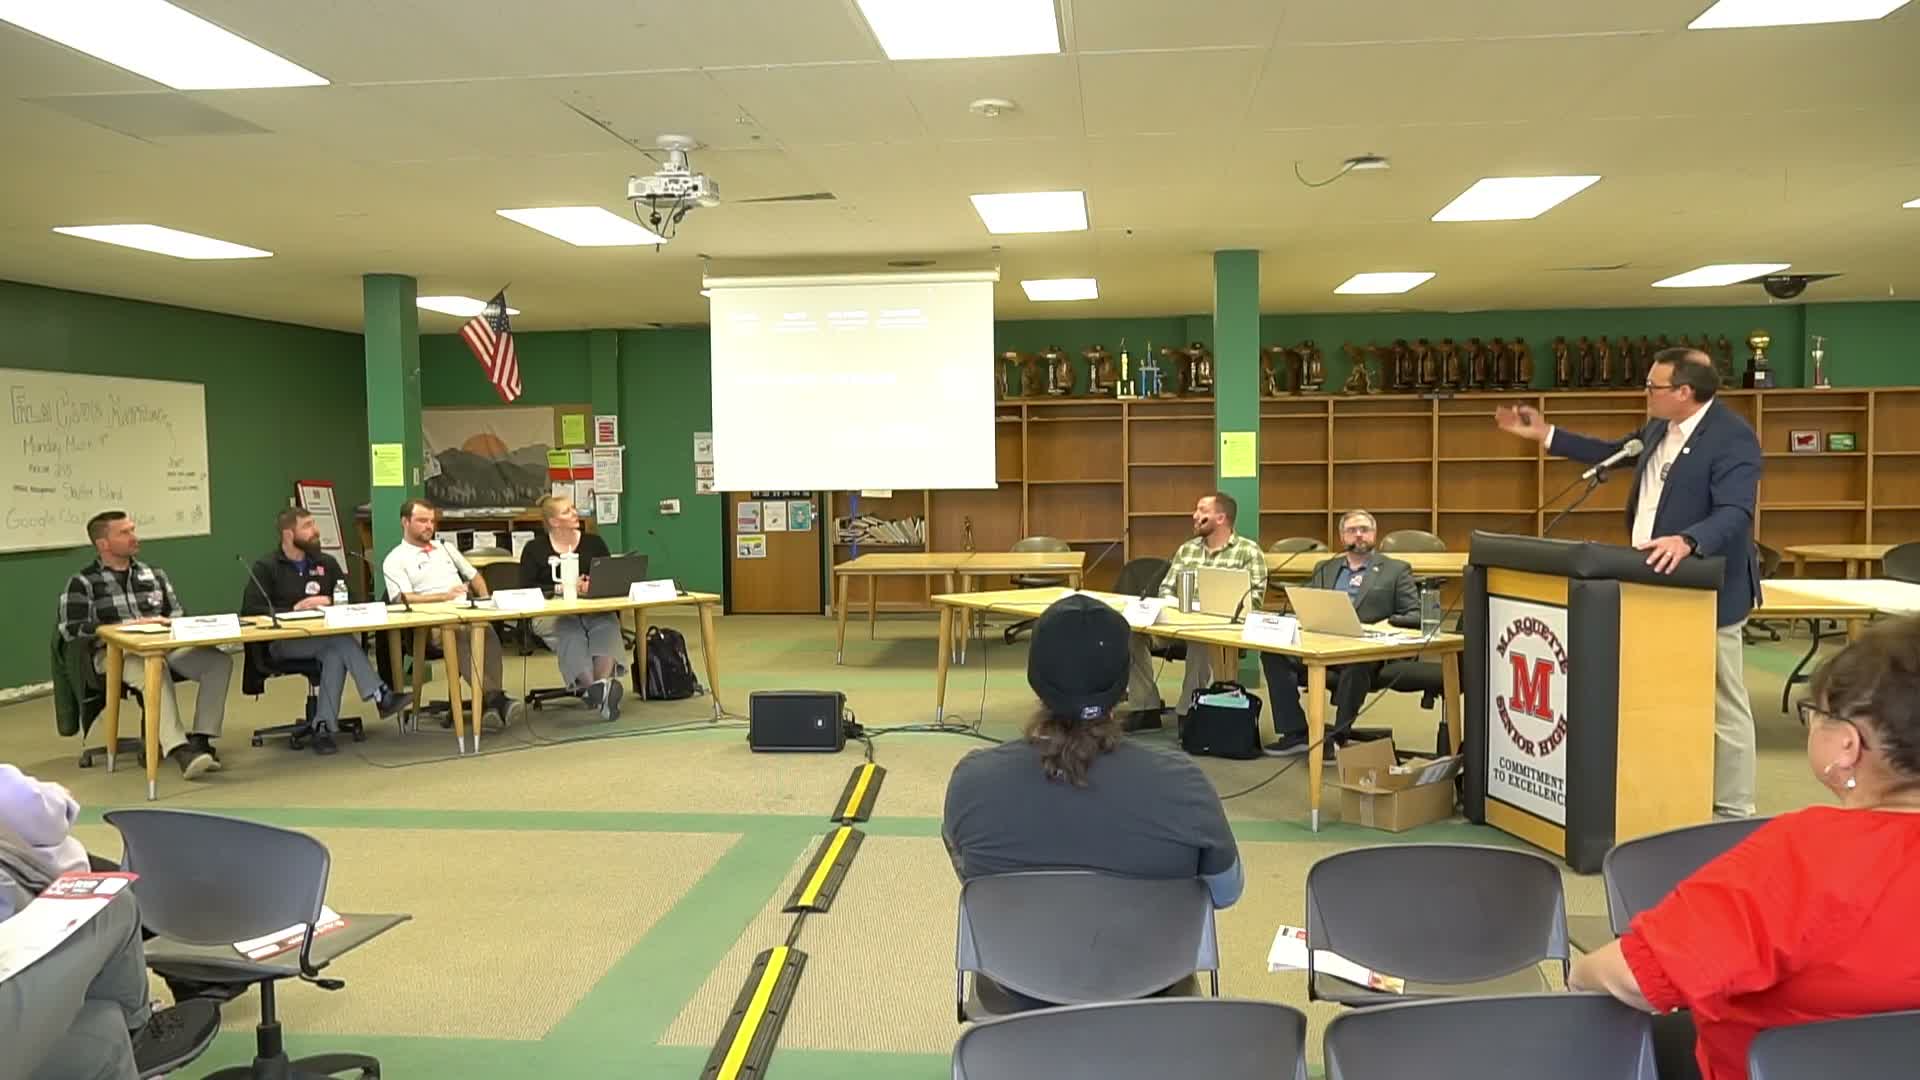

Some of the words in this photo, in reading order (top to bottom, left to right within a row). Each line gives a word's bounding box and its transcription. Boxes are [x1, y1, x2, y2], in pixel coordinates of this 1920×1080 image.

[1496, 617, 1568, 675] MARQUETTE
[1509, 651, 1554, 722] M
[1496, 695, 1536, 758] SENIOR
[1539, 714, 1567, 757] HIGH
[1493, 767, 1506, 782] TO
[1508, 773, 1567, 807] EXCELLENC
[1499, 756, 1564, 791] COMMITMENT
